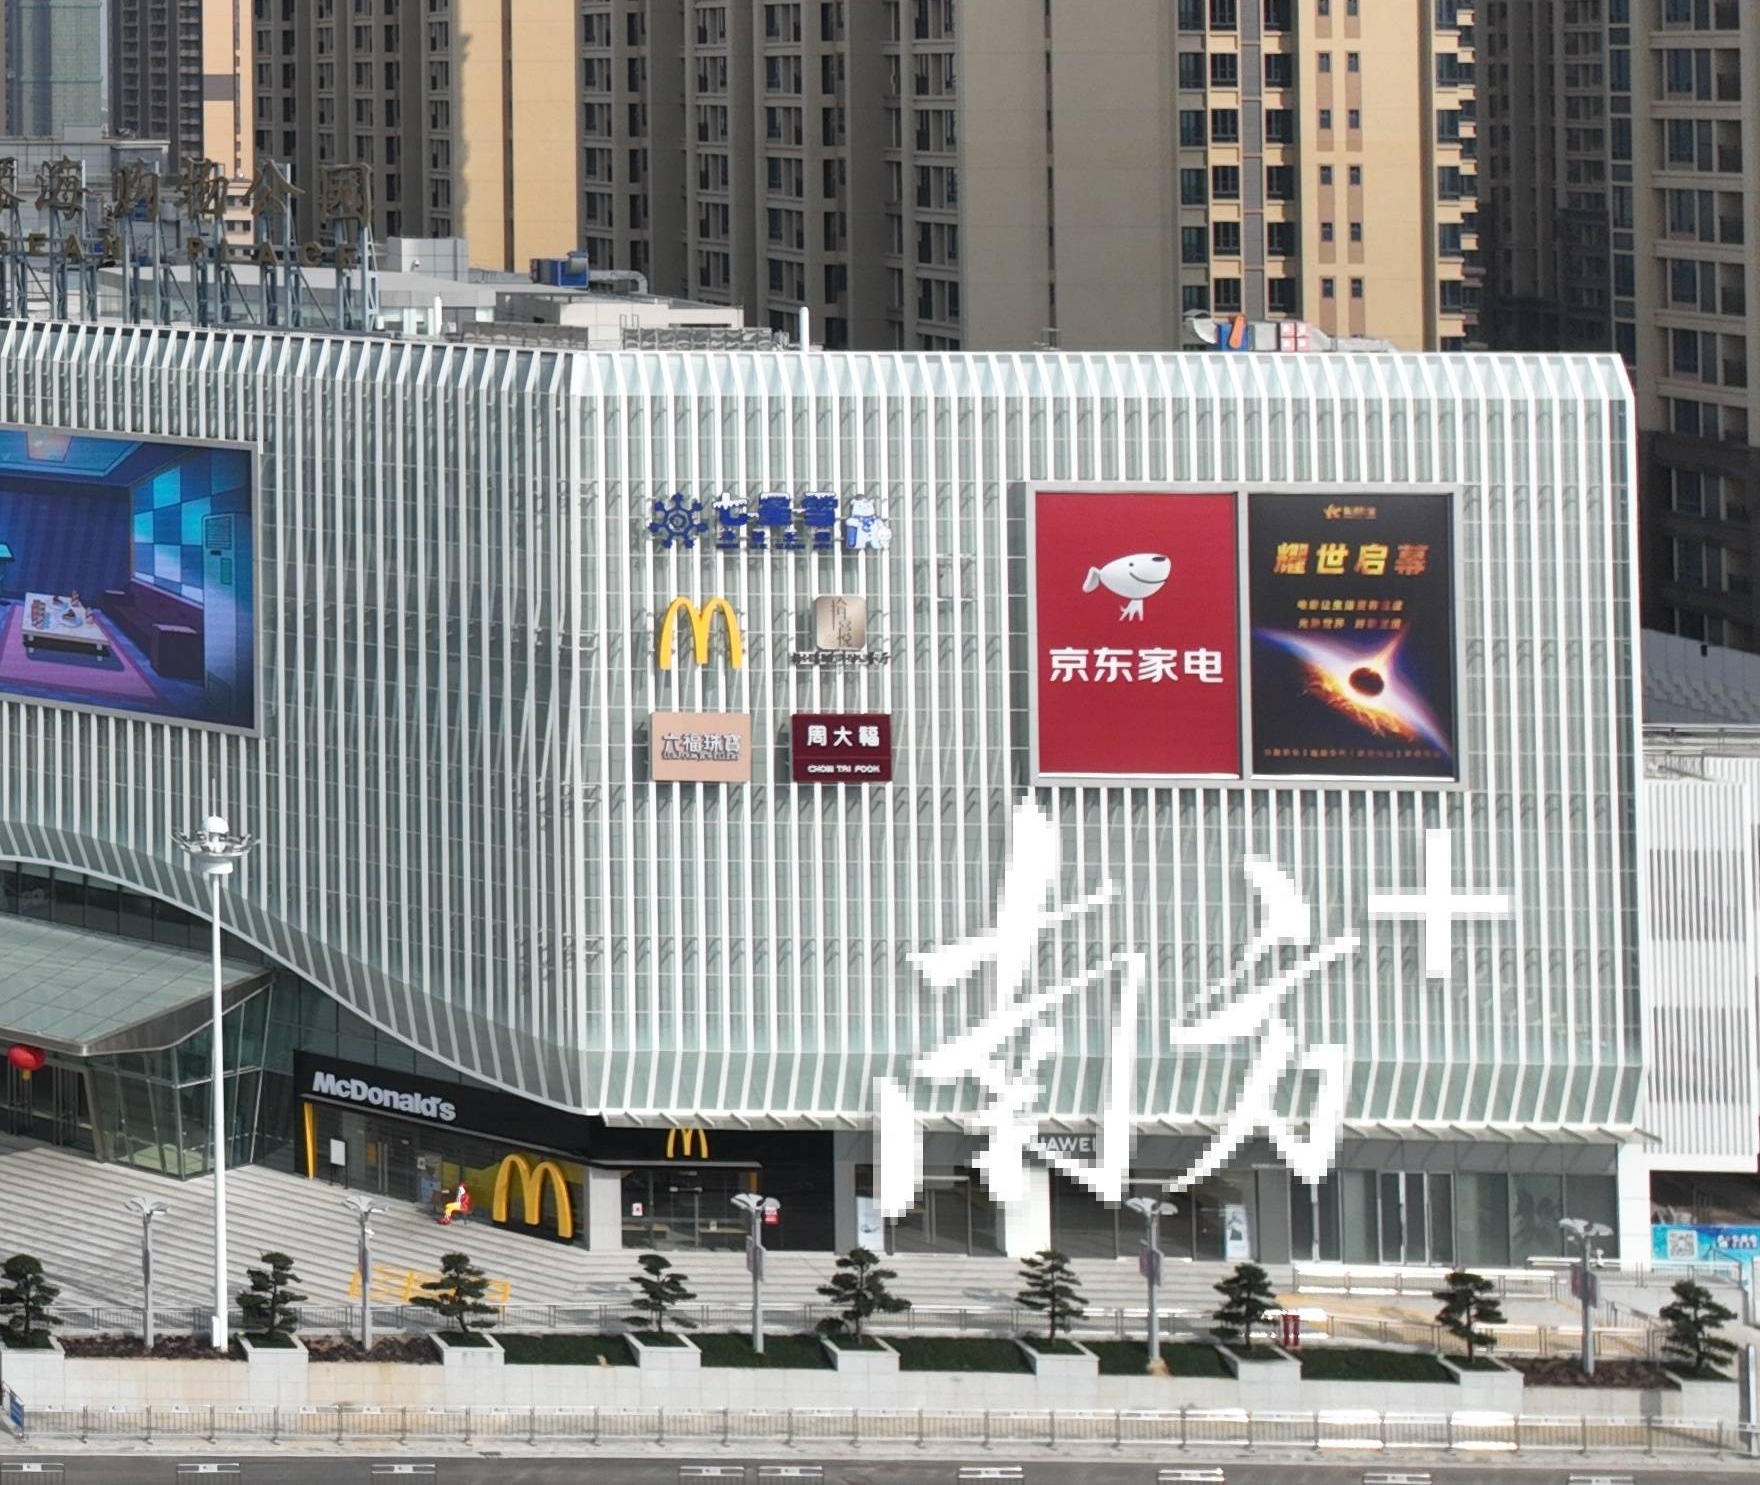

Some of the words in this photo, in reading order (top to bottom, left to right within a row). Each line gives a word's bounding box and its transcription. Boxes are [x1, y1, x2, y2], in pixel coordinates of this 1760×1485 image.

[1273, 542, 1429, 575] 耀世启幕
[1049, 646, 1224, 683] 京东家电
[807, 724, 879, 747] 周大福
[312, 1071, 457, 1122] McDonald's
